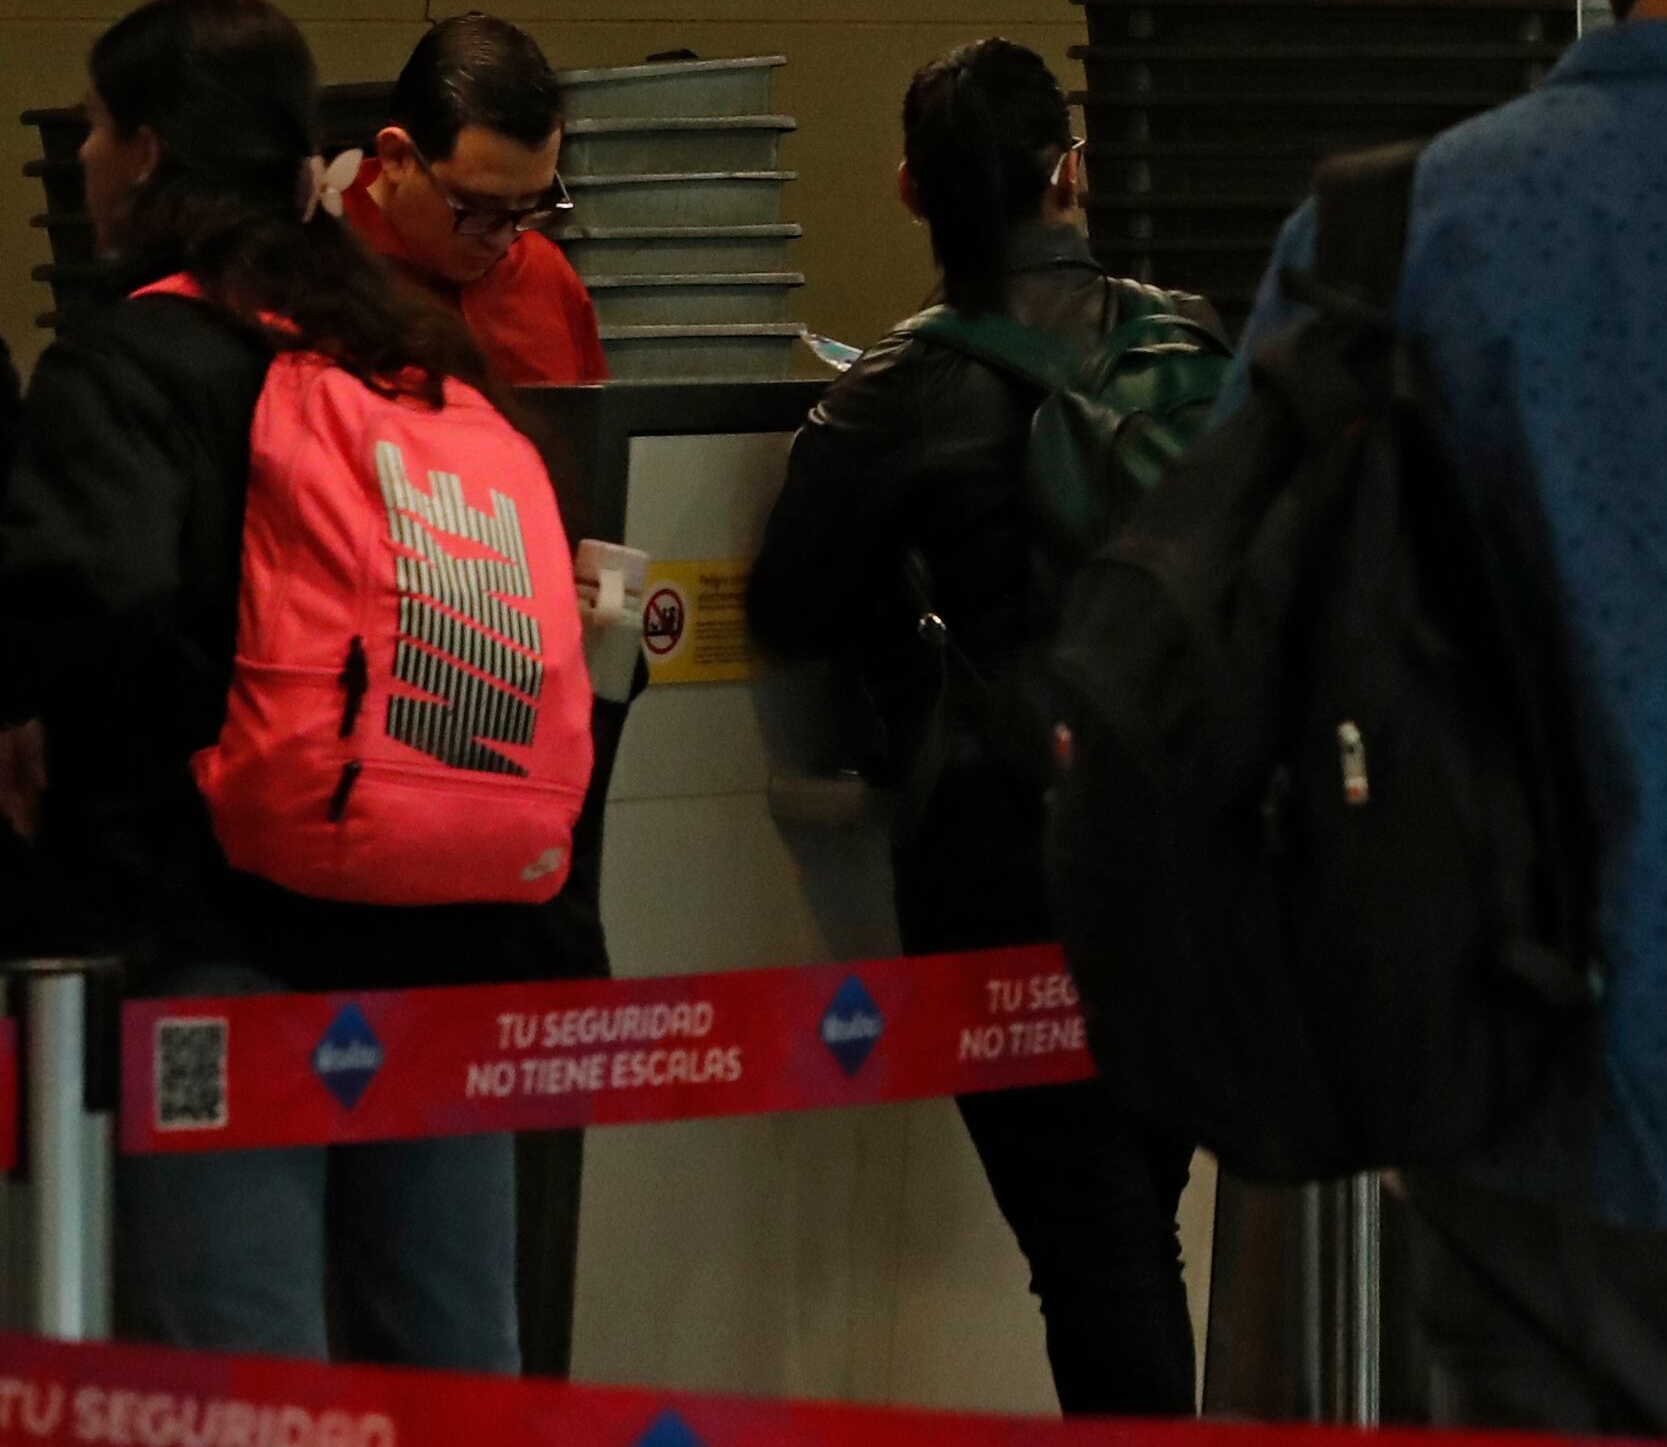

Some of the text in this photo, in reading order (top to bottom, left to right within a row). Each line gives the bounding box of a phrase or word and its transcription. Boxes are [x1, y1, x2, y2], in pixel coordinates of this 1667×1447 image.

[376, 440, 544, 778] NIKE
[986, 979, 1023, 1013] TU
[496, 1001, 715, 1050] TU SEGURIDAD
[959, 1017, 1086, 1061] NO TIENE
[465, 1046, 743, 1098] NO TIENE ESCALAS
